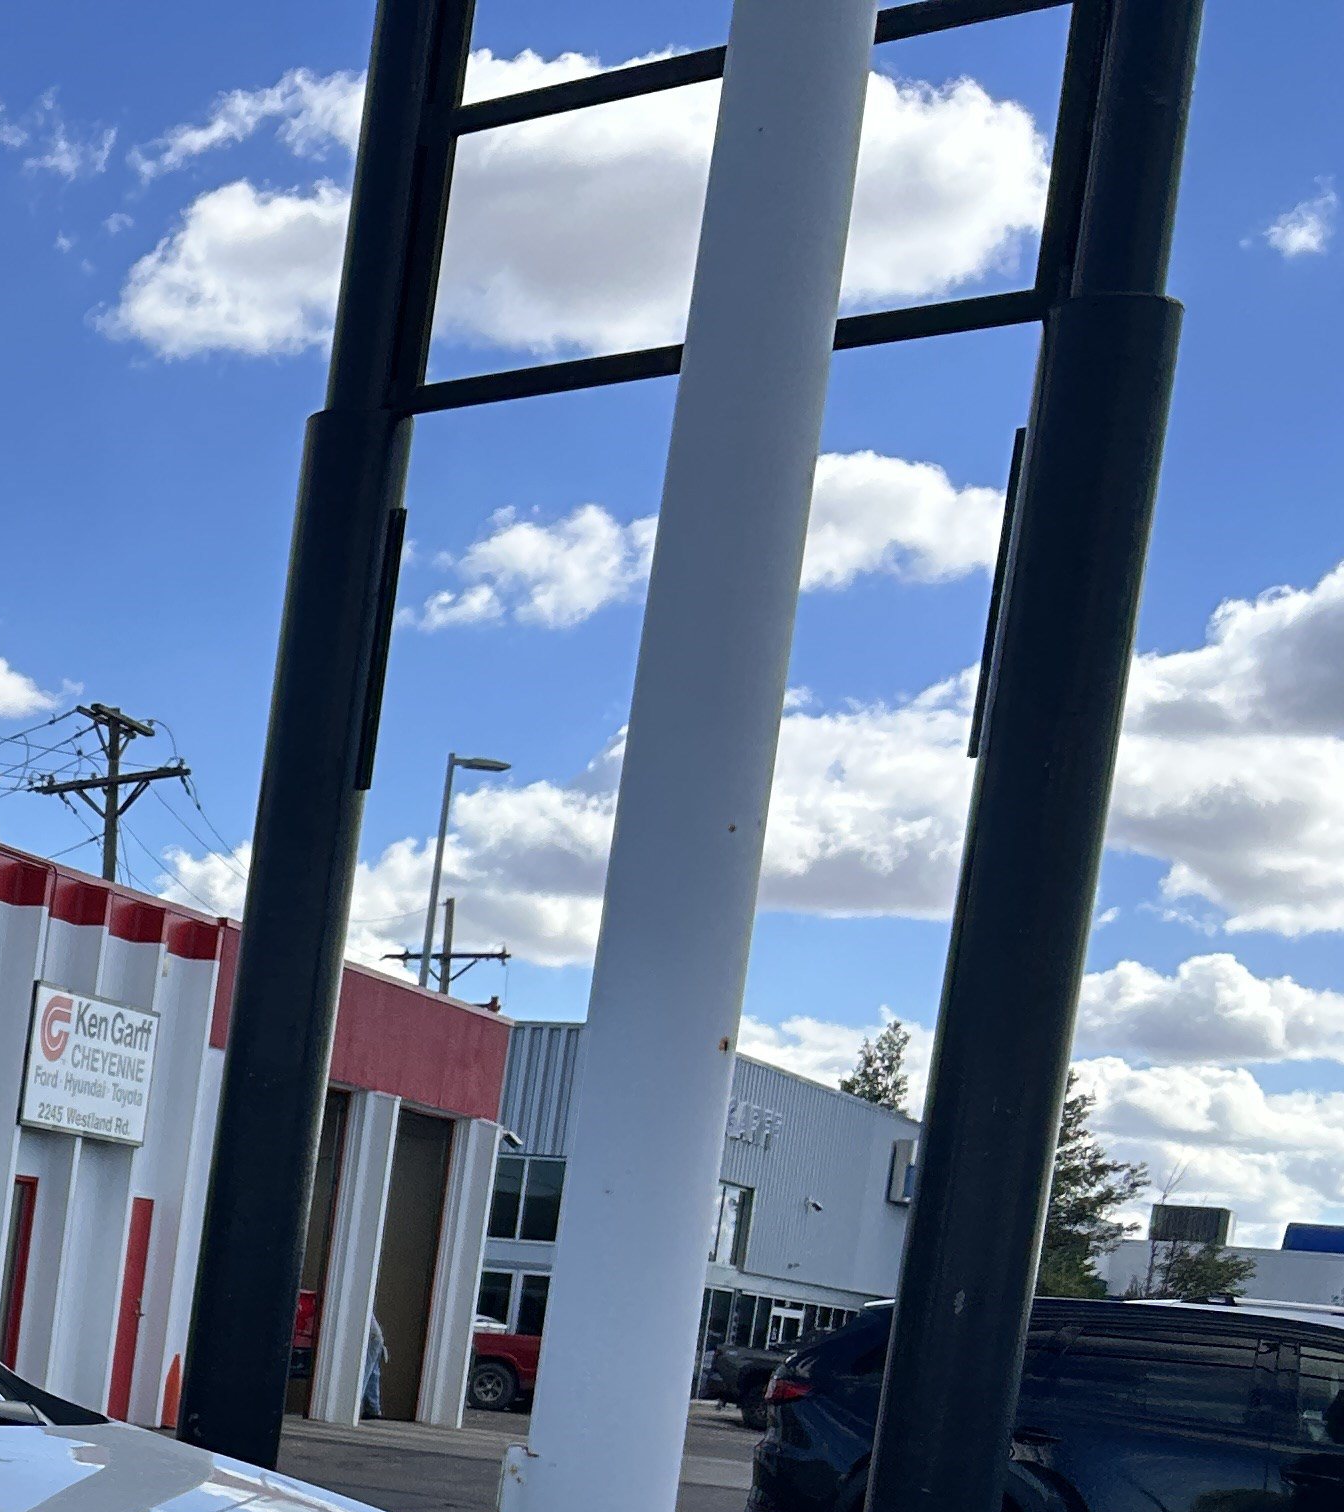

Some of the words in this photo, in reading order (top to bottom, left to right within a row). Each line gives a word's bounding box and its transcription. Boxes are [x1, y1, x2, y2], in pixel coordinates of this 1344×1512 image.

[74, 1001, 109, 1042] Ken
[111, 1011, 153, 1052] Garff
[71, 1044, 145, 1083] CHEYENNE
[34, 1065, 59, 1089] Ford
[64, 1071, 106, 1098] Hyundai
[112, 1082, 143, 1108] Toyota
[37, 1102, 64, 1123] 2245
[66, 1107, 113, 1132] Westland
